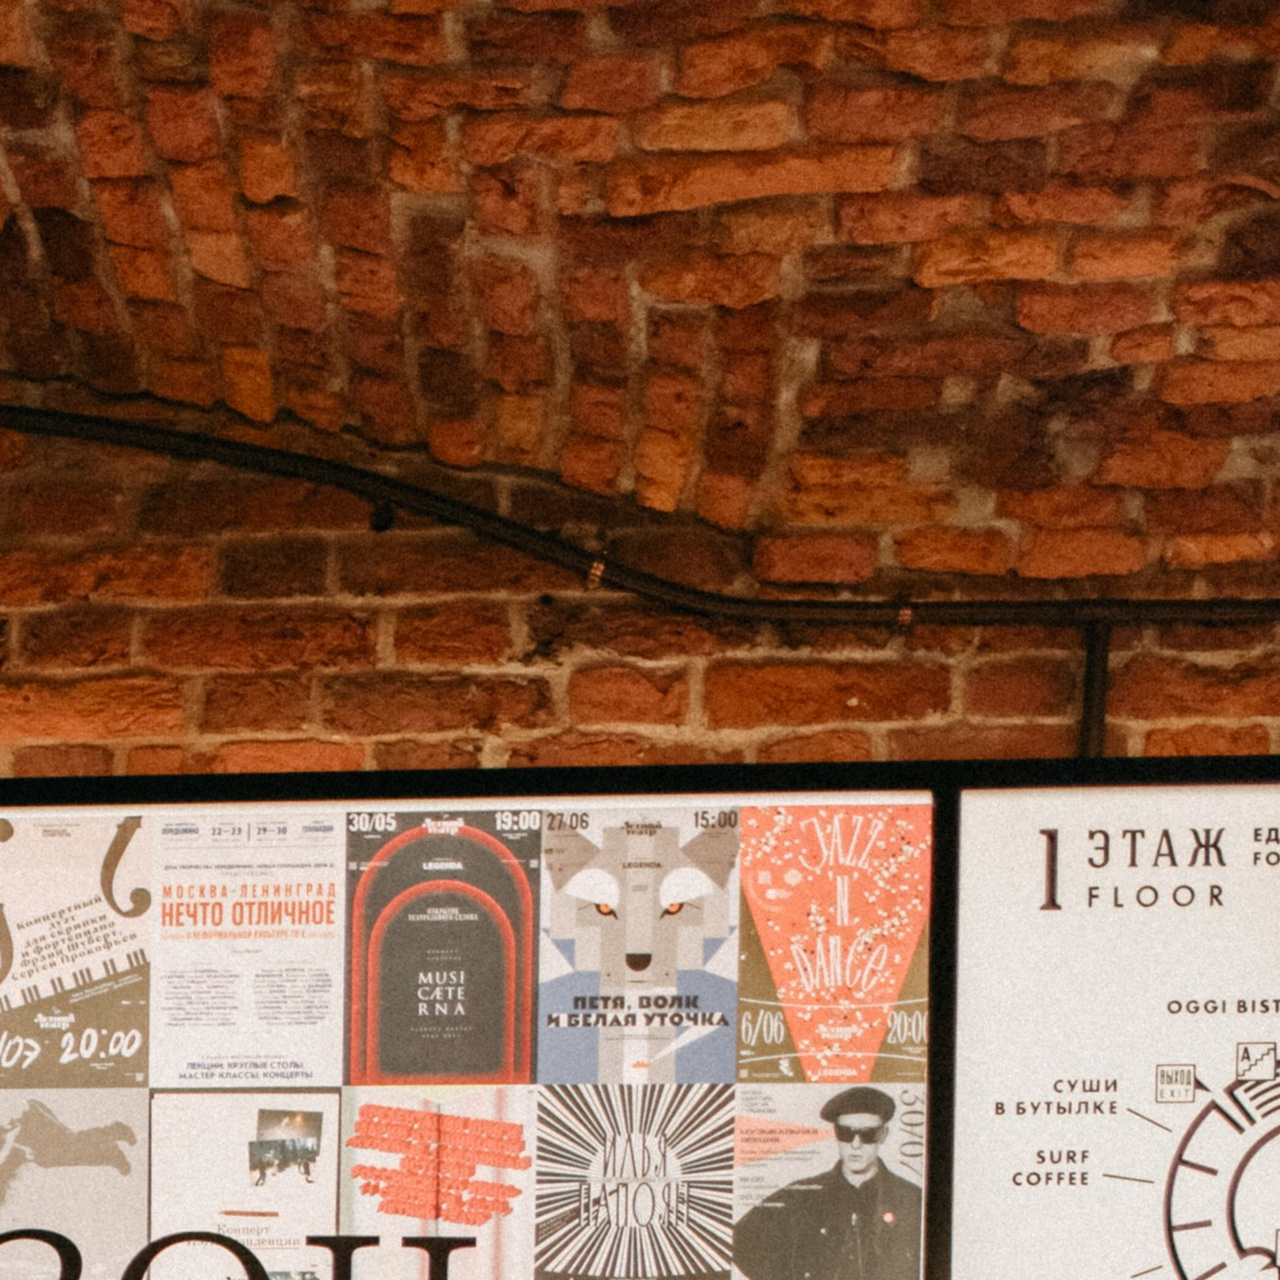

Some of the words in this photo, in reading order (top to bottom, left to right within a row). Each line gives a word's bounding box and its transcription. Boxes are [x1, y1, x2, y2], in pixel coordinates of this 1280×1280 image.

[349, 813, 397, 832] 30/05
[494, 811, 540, 831] 19:00
[694, 811, 738, 829] 15:00
[799, 814, 883, 871] JAZZ
[1088, 828, 1226, 868] ЭТАЖ
[422, 862, 463, 870] LEGENDA
[1088, 885, 1223, 907] FLOOR
[161, 902, 224, 926] НЕЧТО
[231, 901, 335, 926] ОТЛИЧНОЕ
[418, 971, 465, 984] MUSI
[418, 1003, 465, 1015] RNA
[574, 996, 632, 1010] ПЕТЯ,
[639, 996, 699, 1009] ВОЛК
[1167, 1000, 1226, 1014] OGGI
[547, 1015, 559, 1027] И
[568, 1013, 636, 1027] БЕЛАЯ
[651, 1013, 729, 1027] УТОЧКА
[59, 1028, 142, 1064] 20:00
[1160, 1071, 1192, 1085] ВЫХОД
[1053, 1079, 1118, 1093] СУШИ
[995, 1103, 1005, 1115] В
[1016, 1101, 1118, 1115] БУТЫЛКЕ
[1036, 1150, 1090, 1163] SURF
[1012, 1172, 1090, 1186] COFFEE
